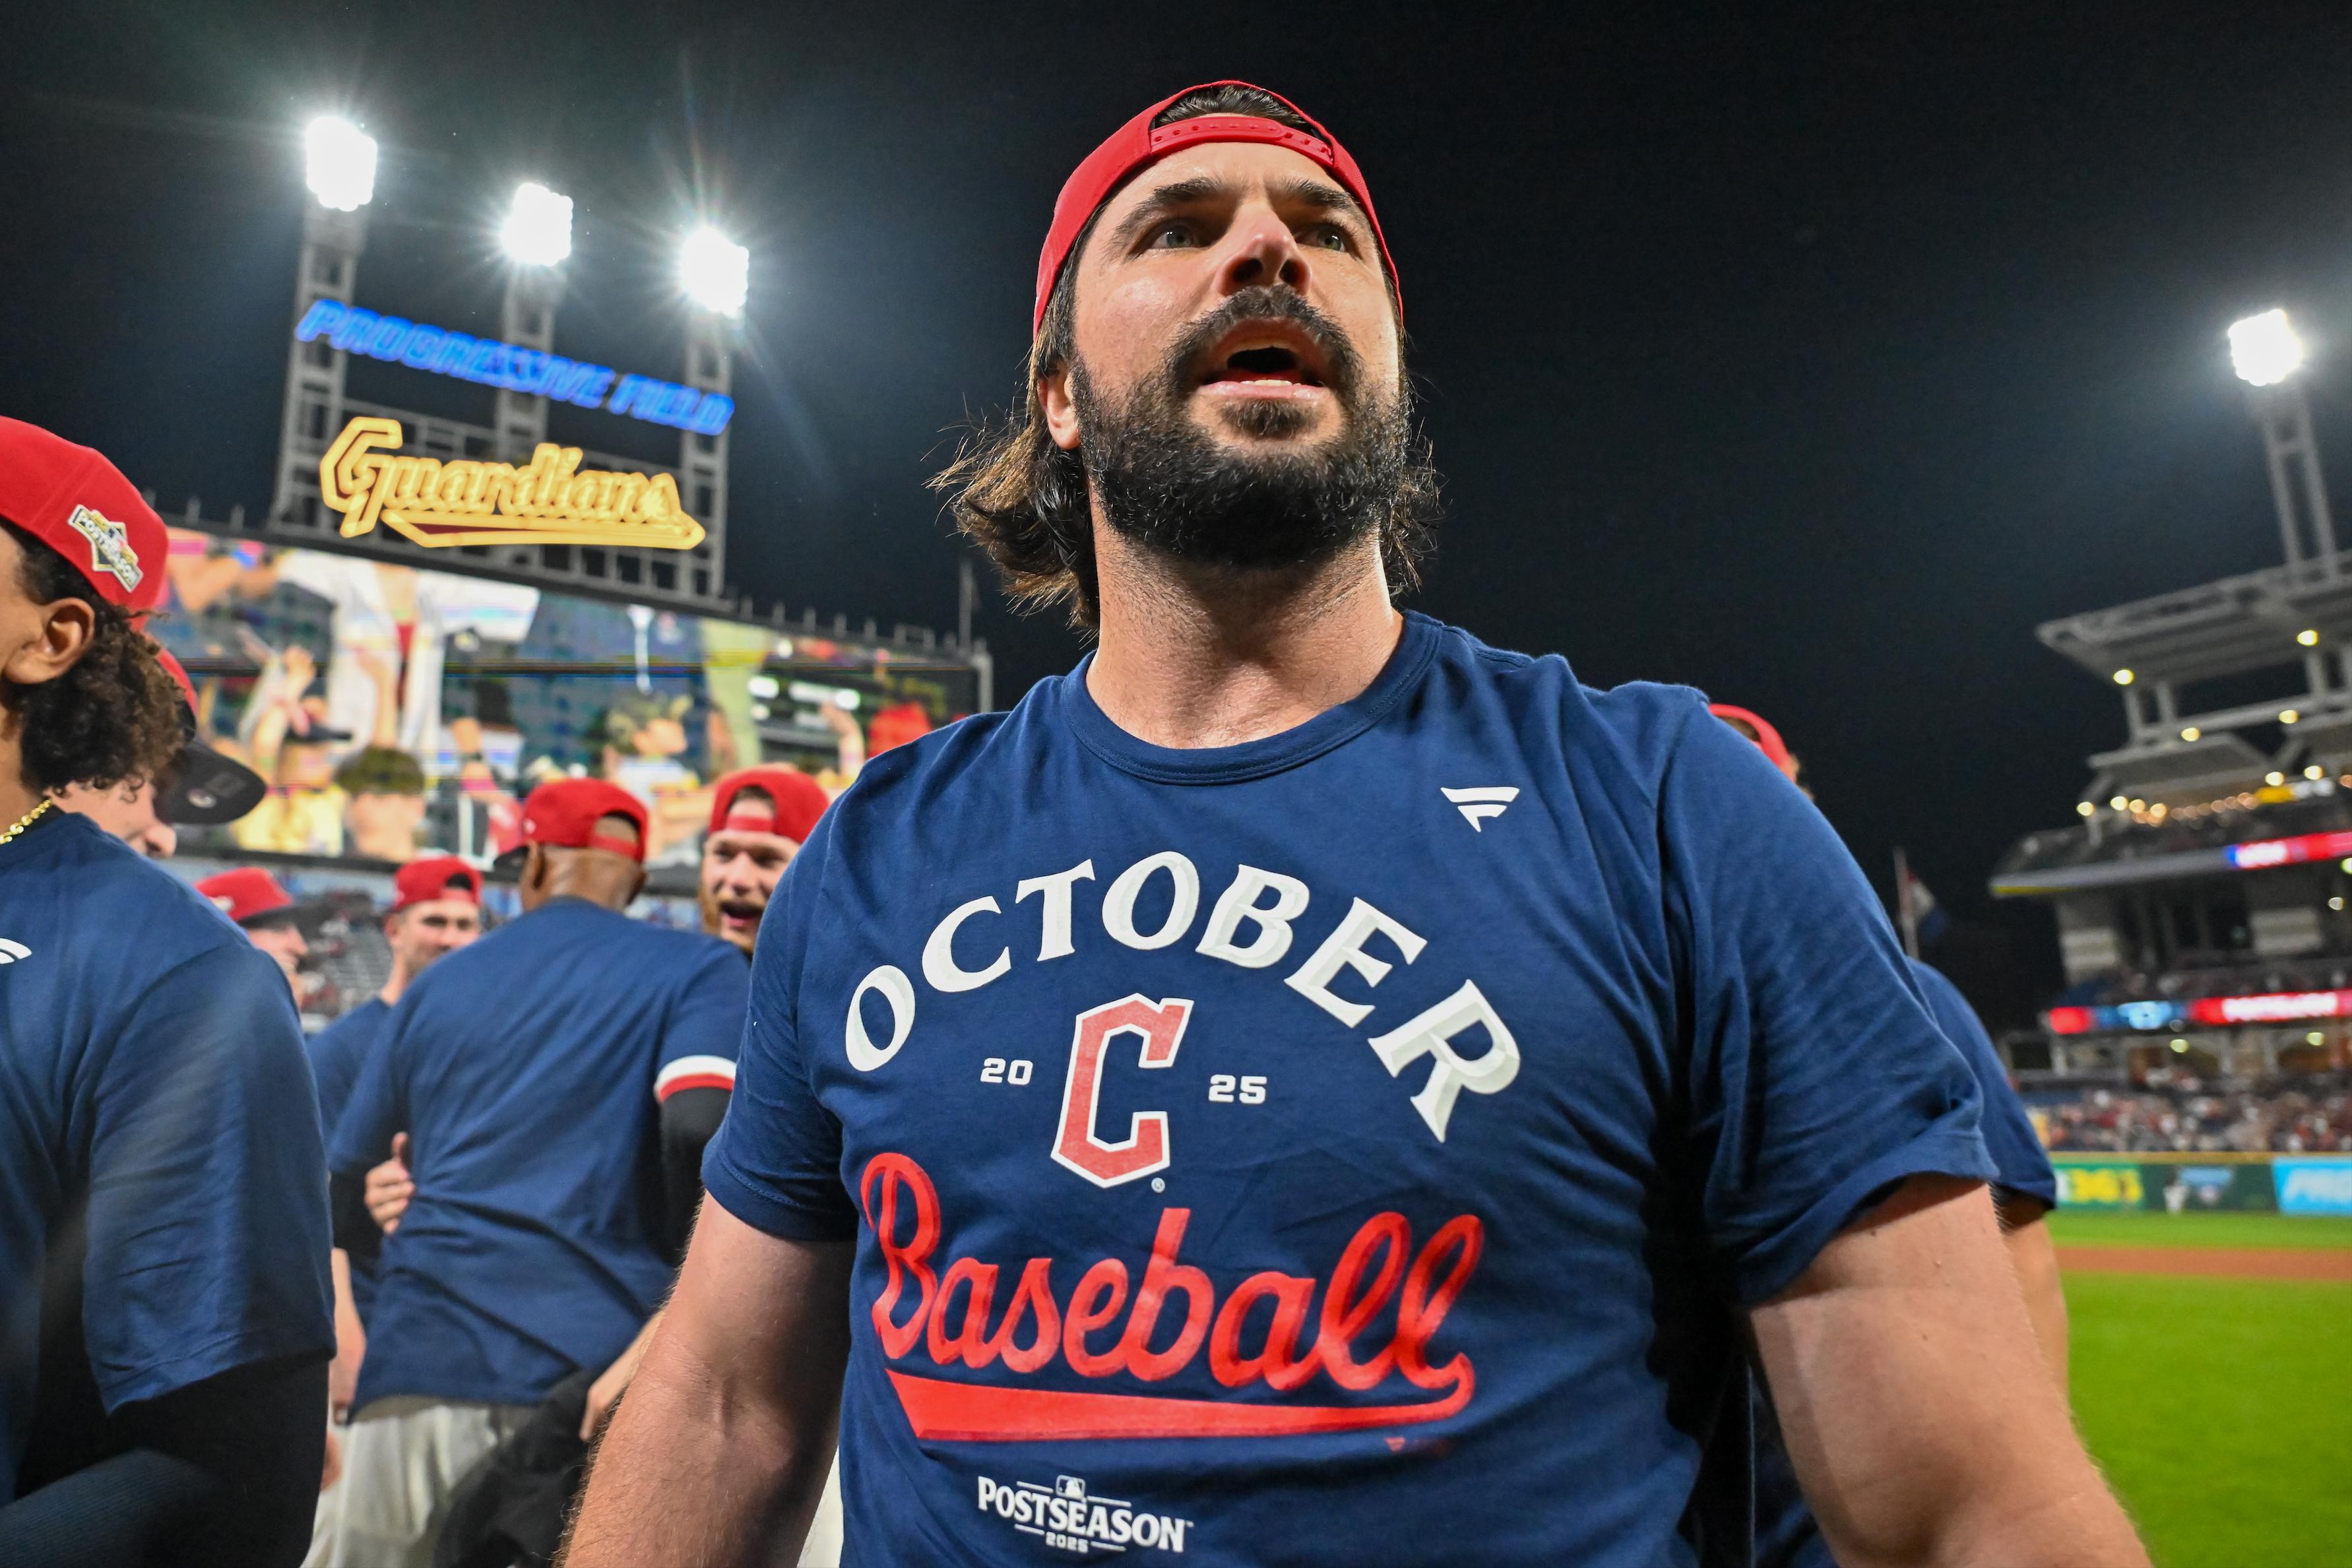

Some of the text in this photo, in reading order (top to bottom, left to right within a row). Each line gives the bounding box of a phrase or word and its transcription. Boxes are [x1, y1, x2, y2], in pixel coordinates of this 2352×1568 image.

[297, 299, 734, 435] PROGRESSIVE FIELD
[320, 416, 694, 538] Guardians
[845, 851, 1521, 1143] OCTOBER
[980, 1058, 1267, 1104] 20 25
[860, 1152, 1483, 1392] Baseball
[978, 1476, 1186, 1553] POSTSEASON
[1046, 1531, 1088, 1553] 2025
